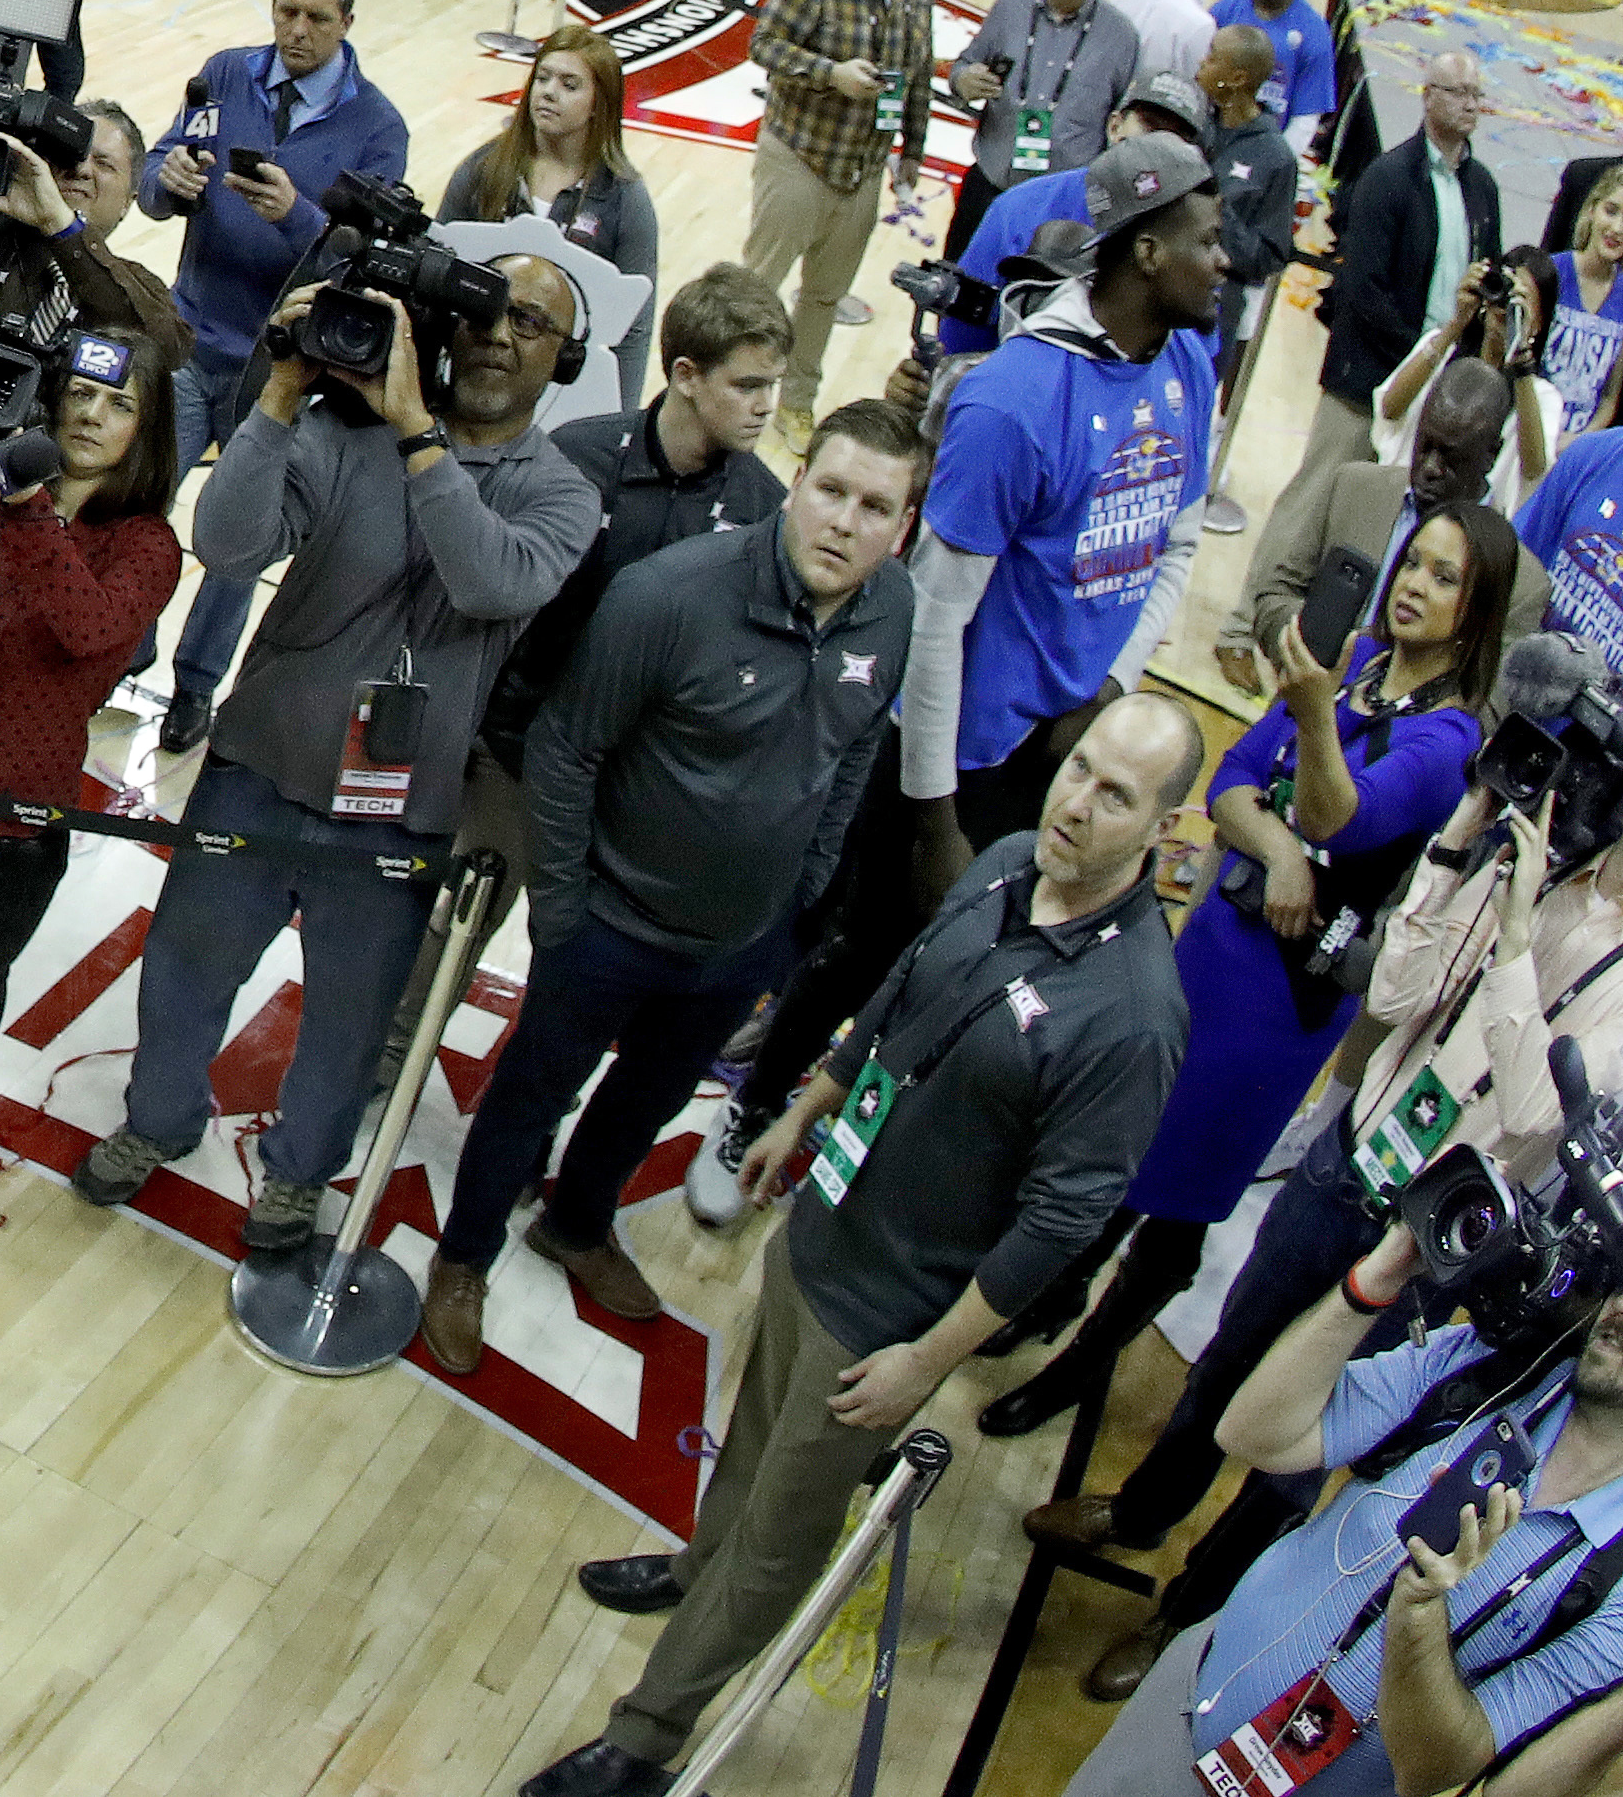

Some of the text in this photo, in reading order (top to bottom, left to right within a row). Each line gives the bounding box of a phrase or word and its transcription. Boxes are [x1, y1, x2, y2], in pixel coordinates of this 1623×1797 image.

[185, 107, 220, 139] 41
[12, 803, 48, 818] Sprint
[343, 798, 395, 812] TECH
[195, 831, 231, 847] Sprint
[1209, 1759, 1243, 1797] TEC
